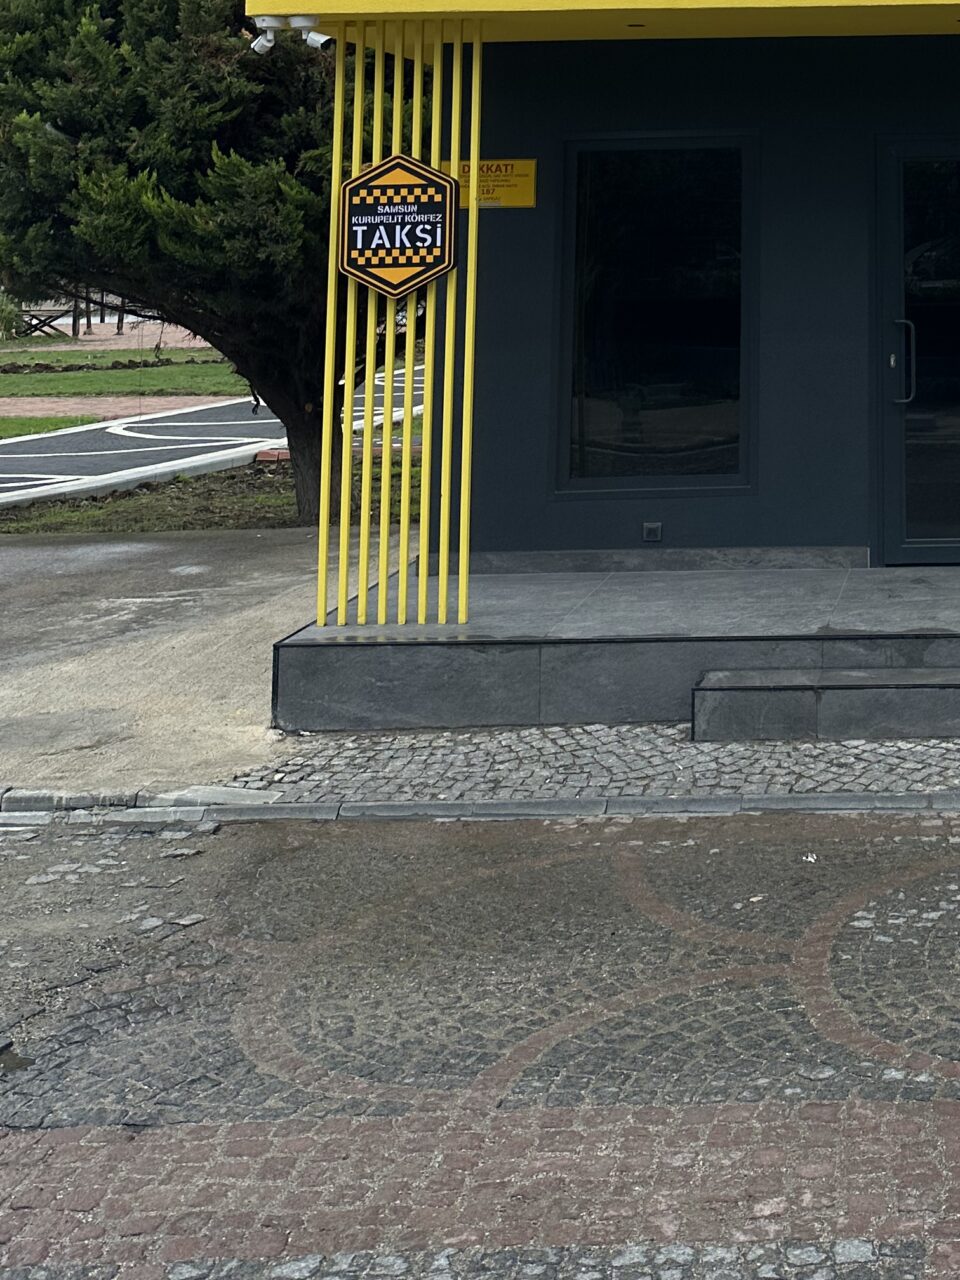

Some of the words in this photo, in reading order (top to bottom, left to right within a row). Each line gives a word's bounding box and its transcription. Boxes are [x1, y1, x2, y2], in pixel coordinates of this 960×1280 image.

[462, 163, 514, 174] DKKAT!
[377, 204, 418, 214] SAMSUN
[404, 213, 443, 223] KÖRFEZ
